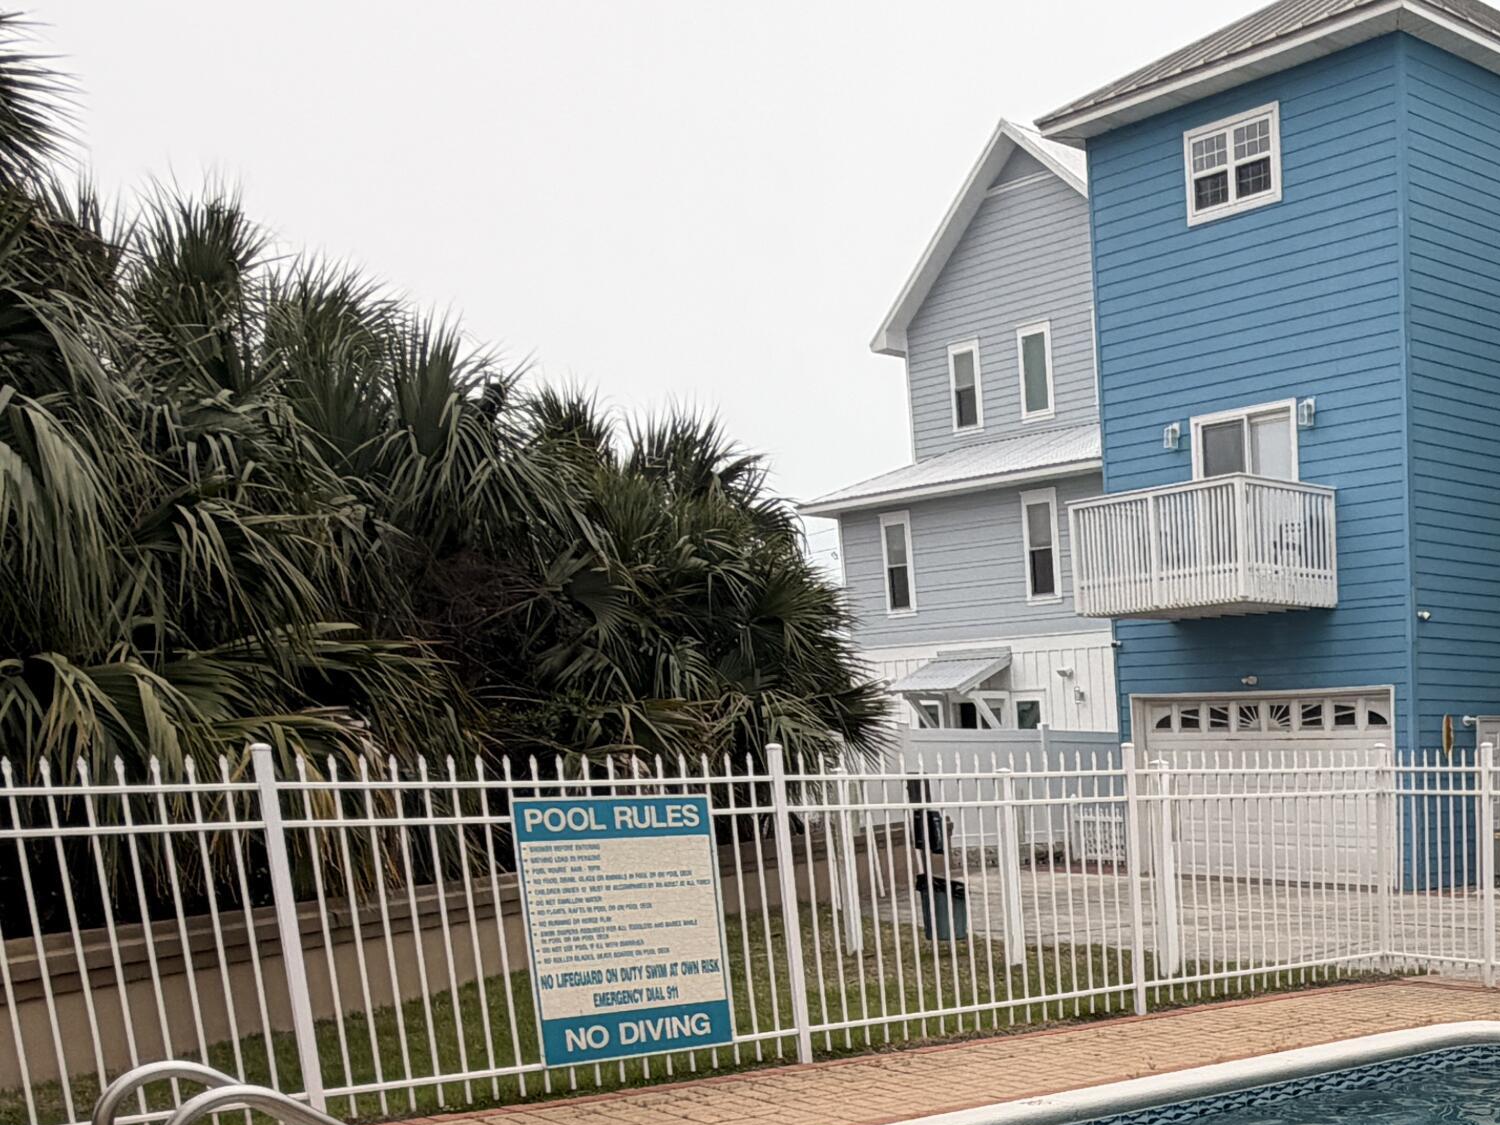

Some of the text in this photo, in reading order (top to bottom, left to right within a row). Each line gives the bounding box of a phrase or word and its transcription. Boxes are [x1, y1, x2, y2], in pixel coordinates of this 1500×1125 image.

[524, 804, 700, 833] POOL RULES
[540, 959, 720, 989] NO LIFEGUARD ON DUTY SWIM AT OWN RISK
[594, 985, 679, 1007] EMERGENCY DIAL 911
[565, 1012, 712, 1052] NO DIVING
